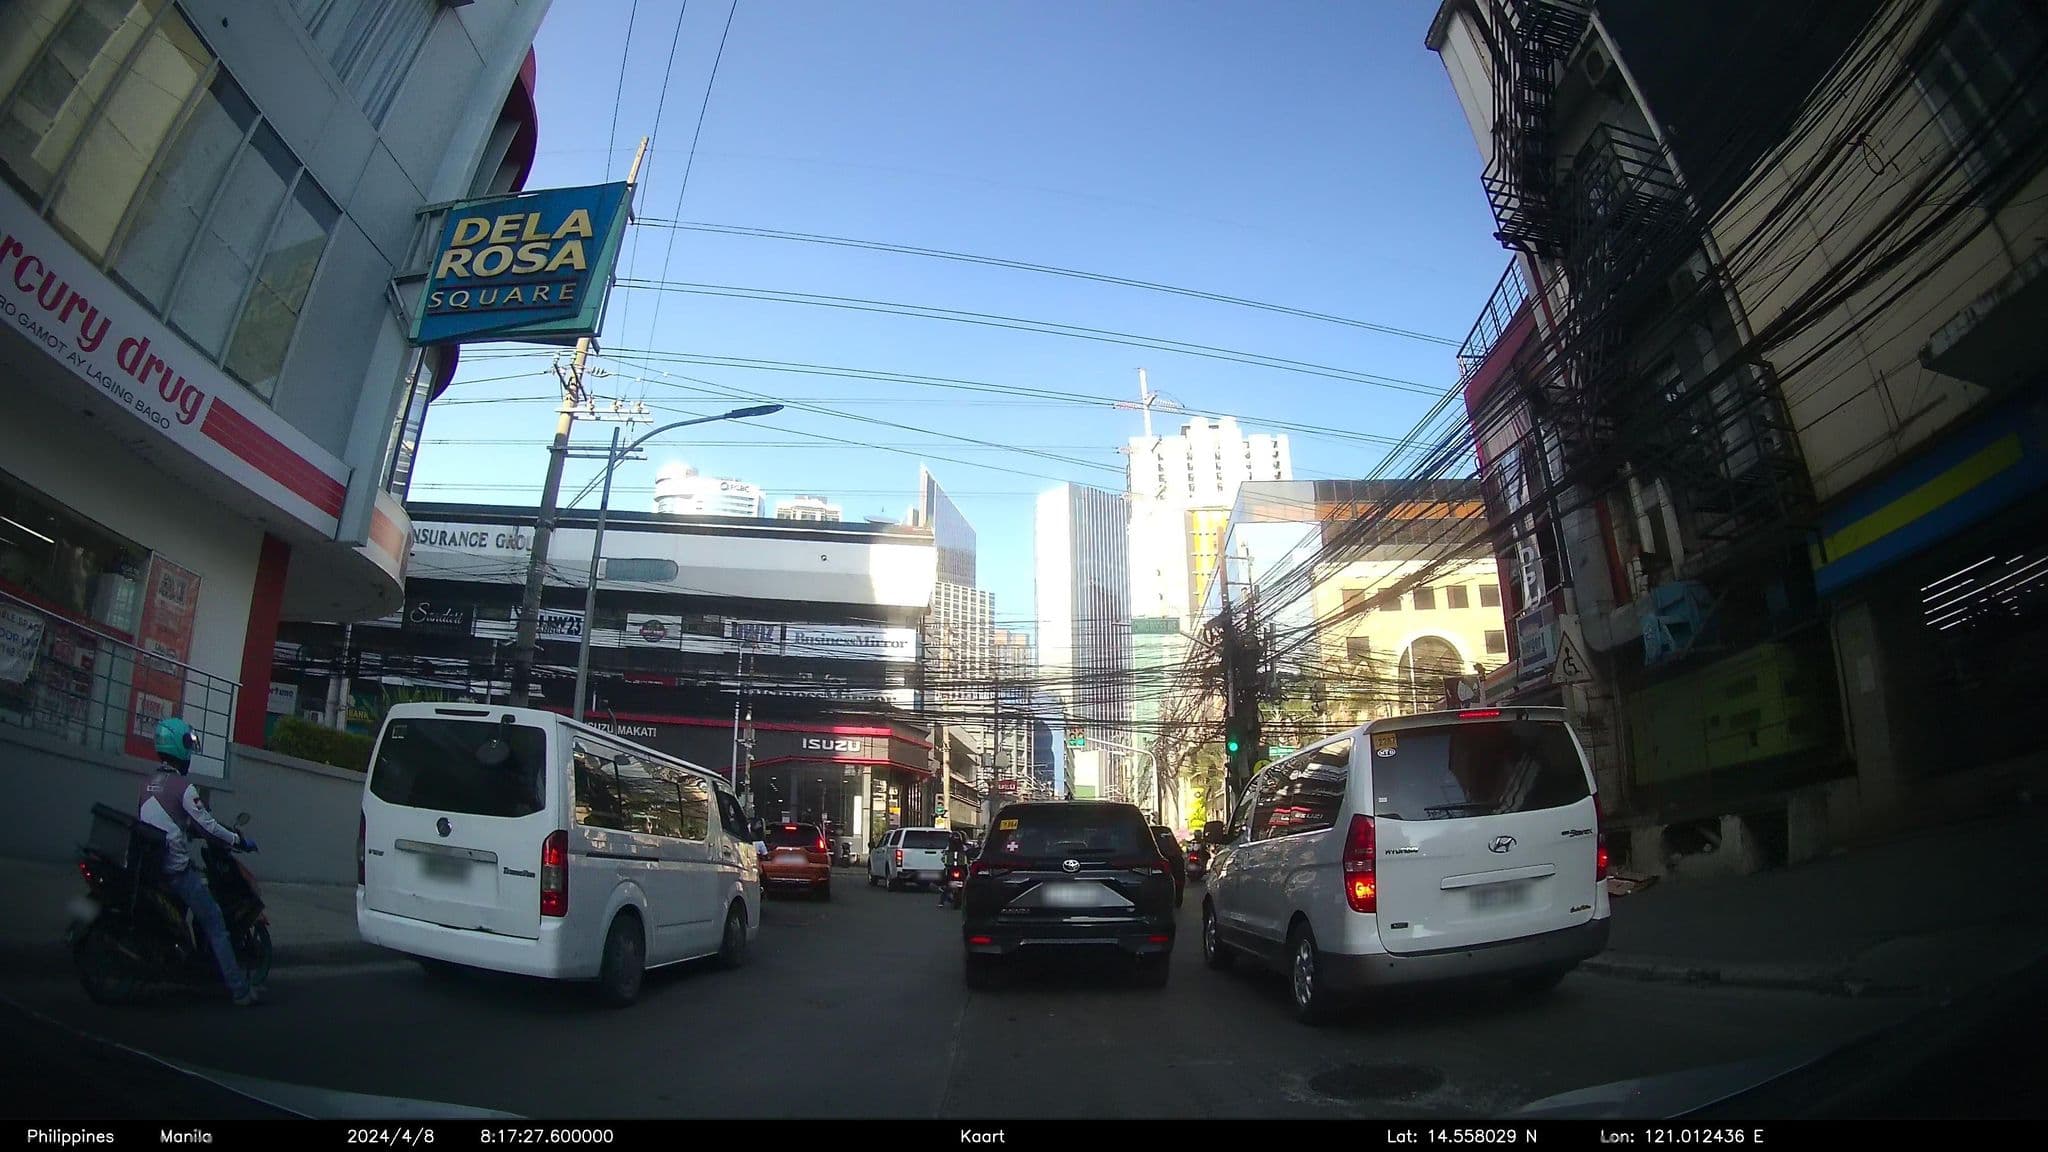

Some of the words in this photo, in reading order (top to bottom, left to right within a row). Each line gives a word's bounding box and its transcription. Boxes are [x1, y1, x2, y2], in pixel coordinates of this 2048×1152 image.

[451, 209, 592, 247] DELA
[435, 240, 587, 280] ROSA
[428, 284, 577, 308] SQUARE
[0, 231, 112, 353] rcury
[116, 335, 206, 426] drug
[0, 294, 17, 317] RO
[18, 313, 69, 353] GAMOT
[67, 349, 86, 368] AY
[86, 366, 135, 405] LAGING
[135, 399, 171, 430] BAGO
[412, 528, 489, 548] NSURANCE
[794, 632, 908, 648] BusinessMirror
[617, 724, 657, 737] MAKATI
[802, 737, 861, 752] ISUZU
